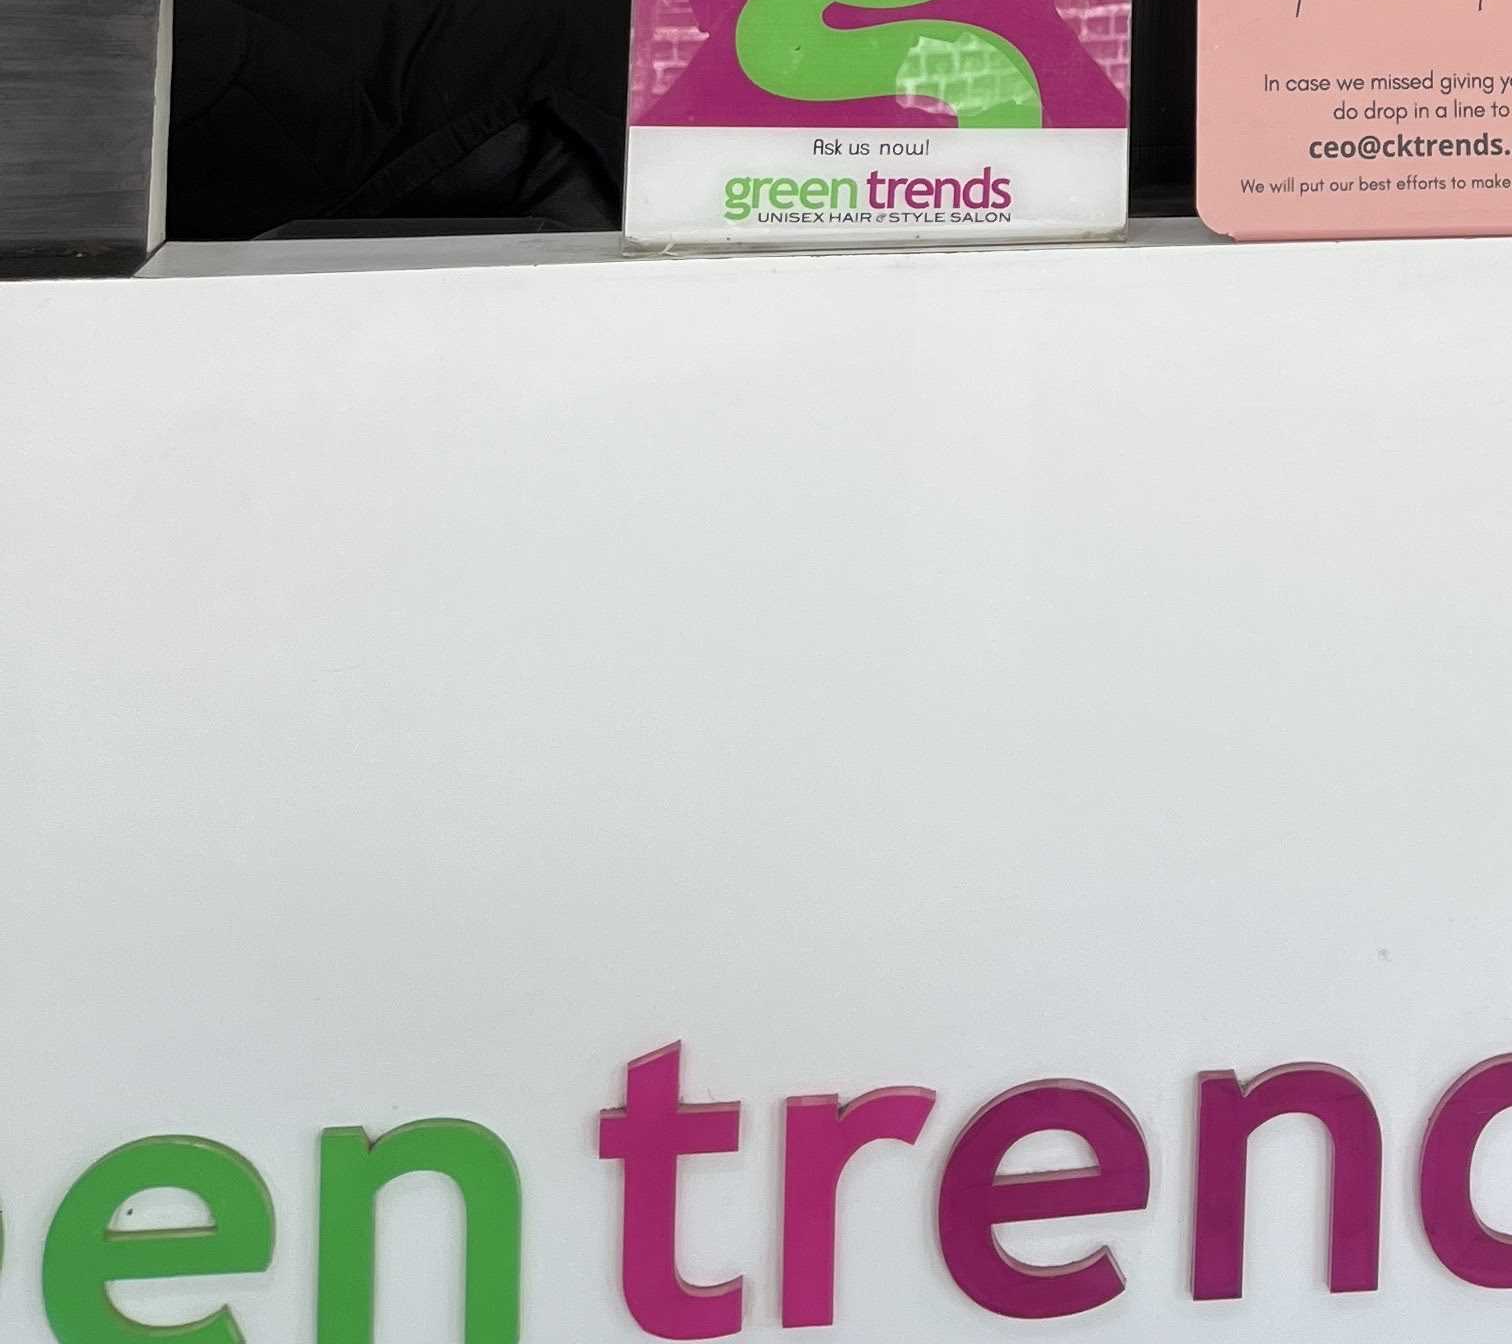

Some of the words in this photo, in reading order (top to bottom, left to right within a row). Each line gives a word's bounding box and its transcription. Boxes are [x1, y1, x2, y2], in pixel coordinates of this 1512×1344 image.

[1264, 74, 1280, 92] In
[1286, 76, 1331, 92] case
[1337, 76, 1366, 92] we
[1370, 70, 1434, 91] missed
[1440, 72, 1495, 95] giving
[1333, 100, 1359, 121] do
[1364, 100, 1408, 125] drop
[1414, 100, 1430, 119] in
[1434, 104, 1448, 119] a
[1453, 98, 1486, 119] line
[1489, 99, 1511, 119] to
[812, 138, 842, 156] Ask
[848, 142, 871, 156] us
[880, 138, 930, 156] now!
[724, 175, 858, 222] green
[866, 166, 1012, 210] trends
[1241, 178, 1266, 194] We
[1269, 176, 1296, 194] will
[1300, 178, 1326, 197] put
[1329, 179, 1355, 192] our
[1359, 175, 1392, 192] best
[1396, 174, 1448, 192] efforts
[1450, 174, 1467, 190] to
[1471, 173, 1512, 190] make
[757, 211, 825, 224] UNISEX
[828, 212, 873, 224] HAIR
[888, 211, 946, 223] STYLE
[950, 211, 1012, 224] SALON
